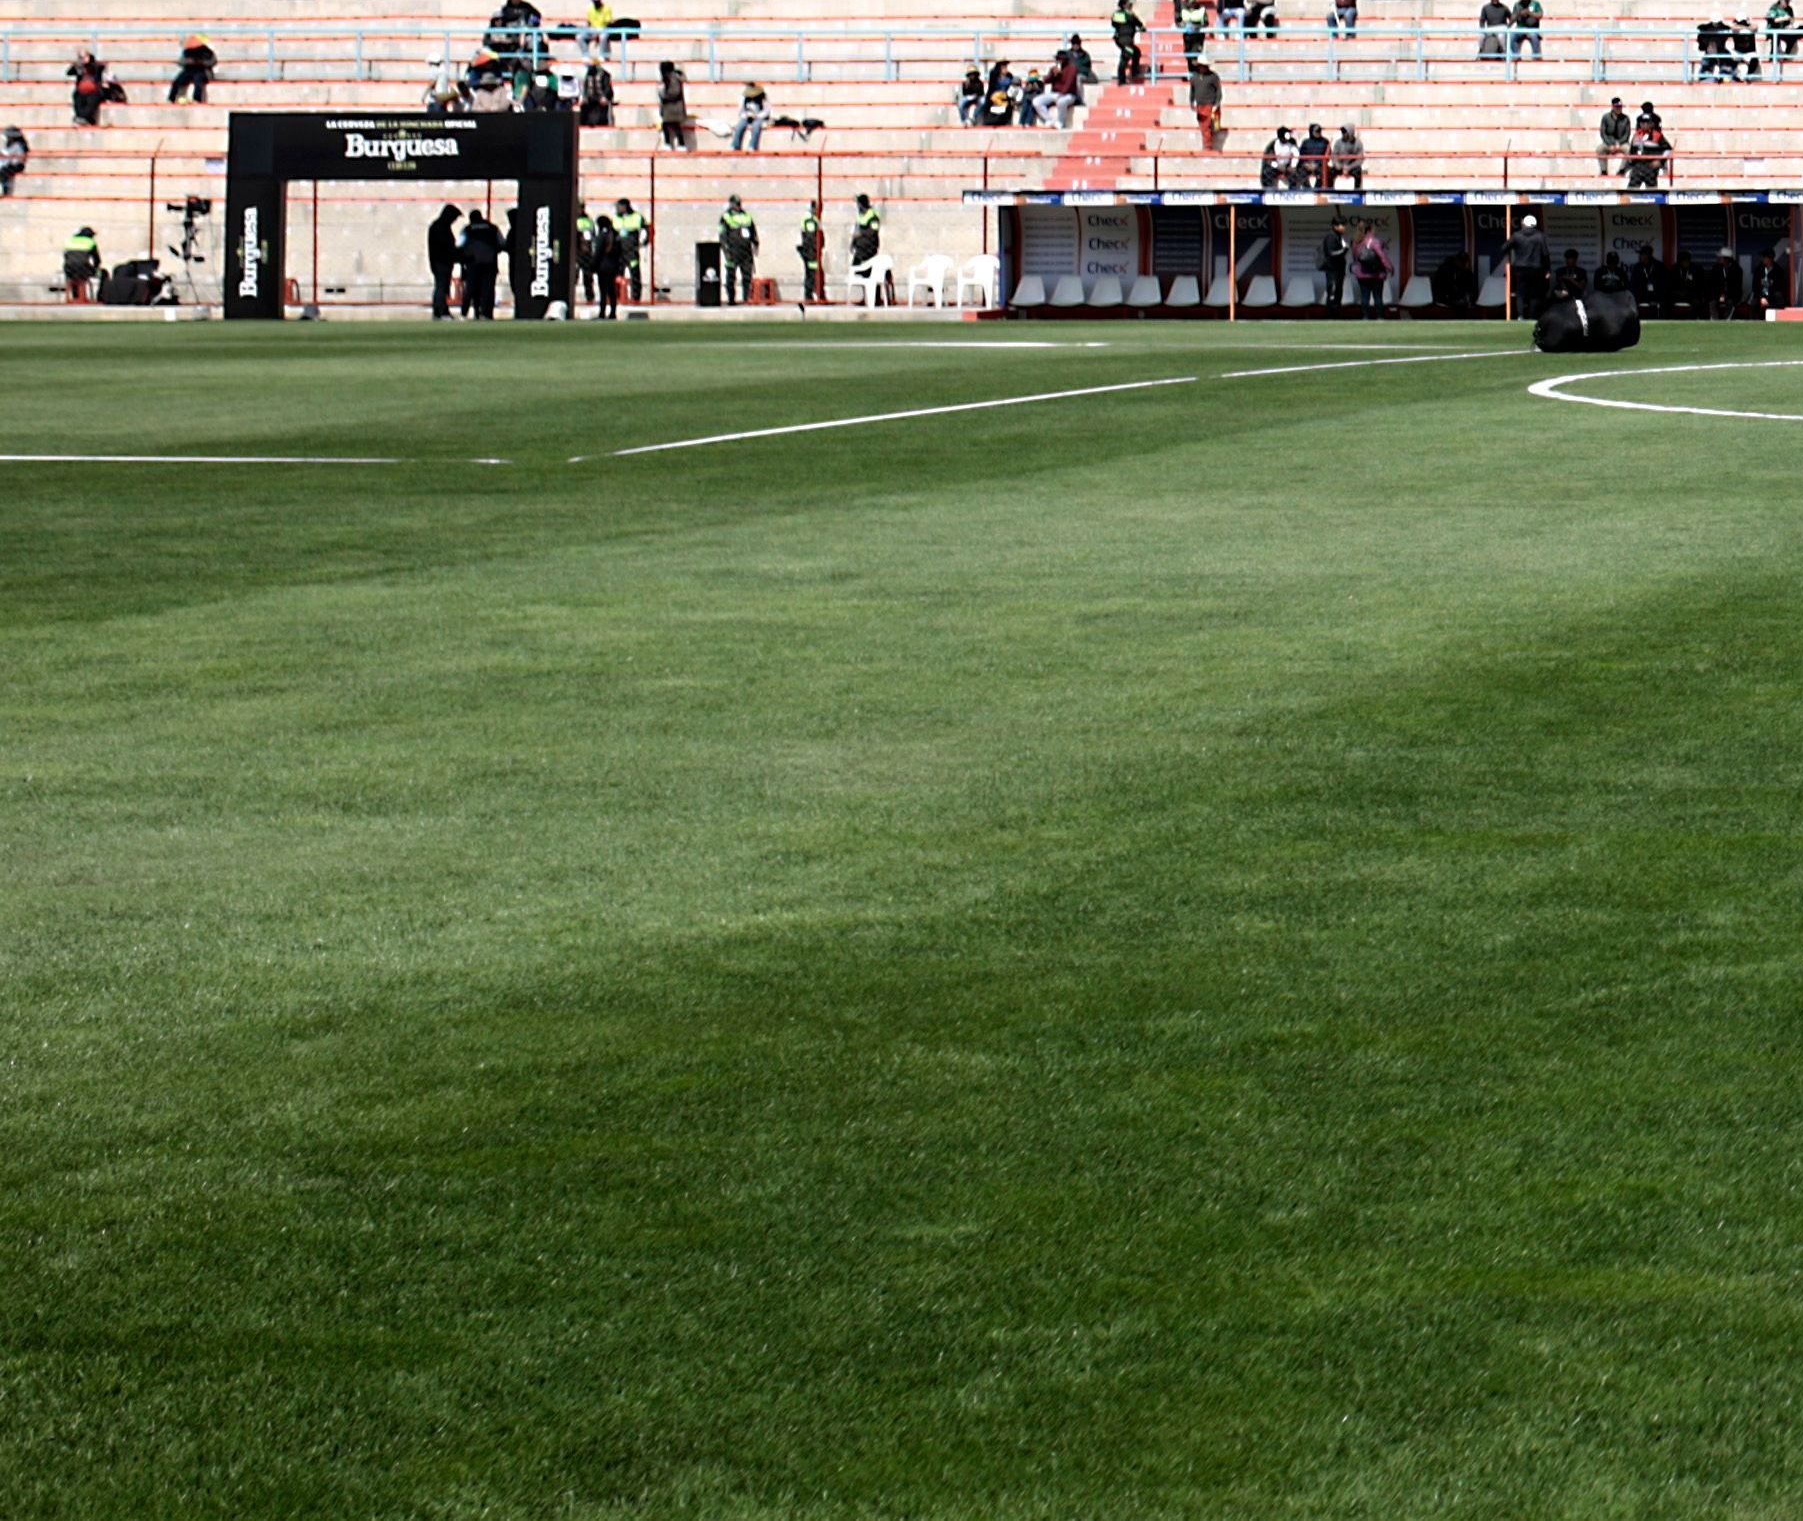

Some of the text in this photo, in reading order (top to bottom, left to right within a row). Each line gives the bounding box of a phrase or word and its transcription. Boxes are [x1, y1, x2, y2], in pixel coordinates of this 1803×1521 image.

[344, 133, 459, 162] Burguesa
[1088, 214, 1129, 228] Check
[1612, 214, 1654, 227] Check
[239, 205, 260, 297] Burguesa
[531, 205, 553, 297] Burguesa
[1088, 236, 1130, 251] Check
[1087, 260, 1129, 275] Check
